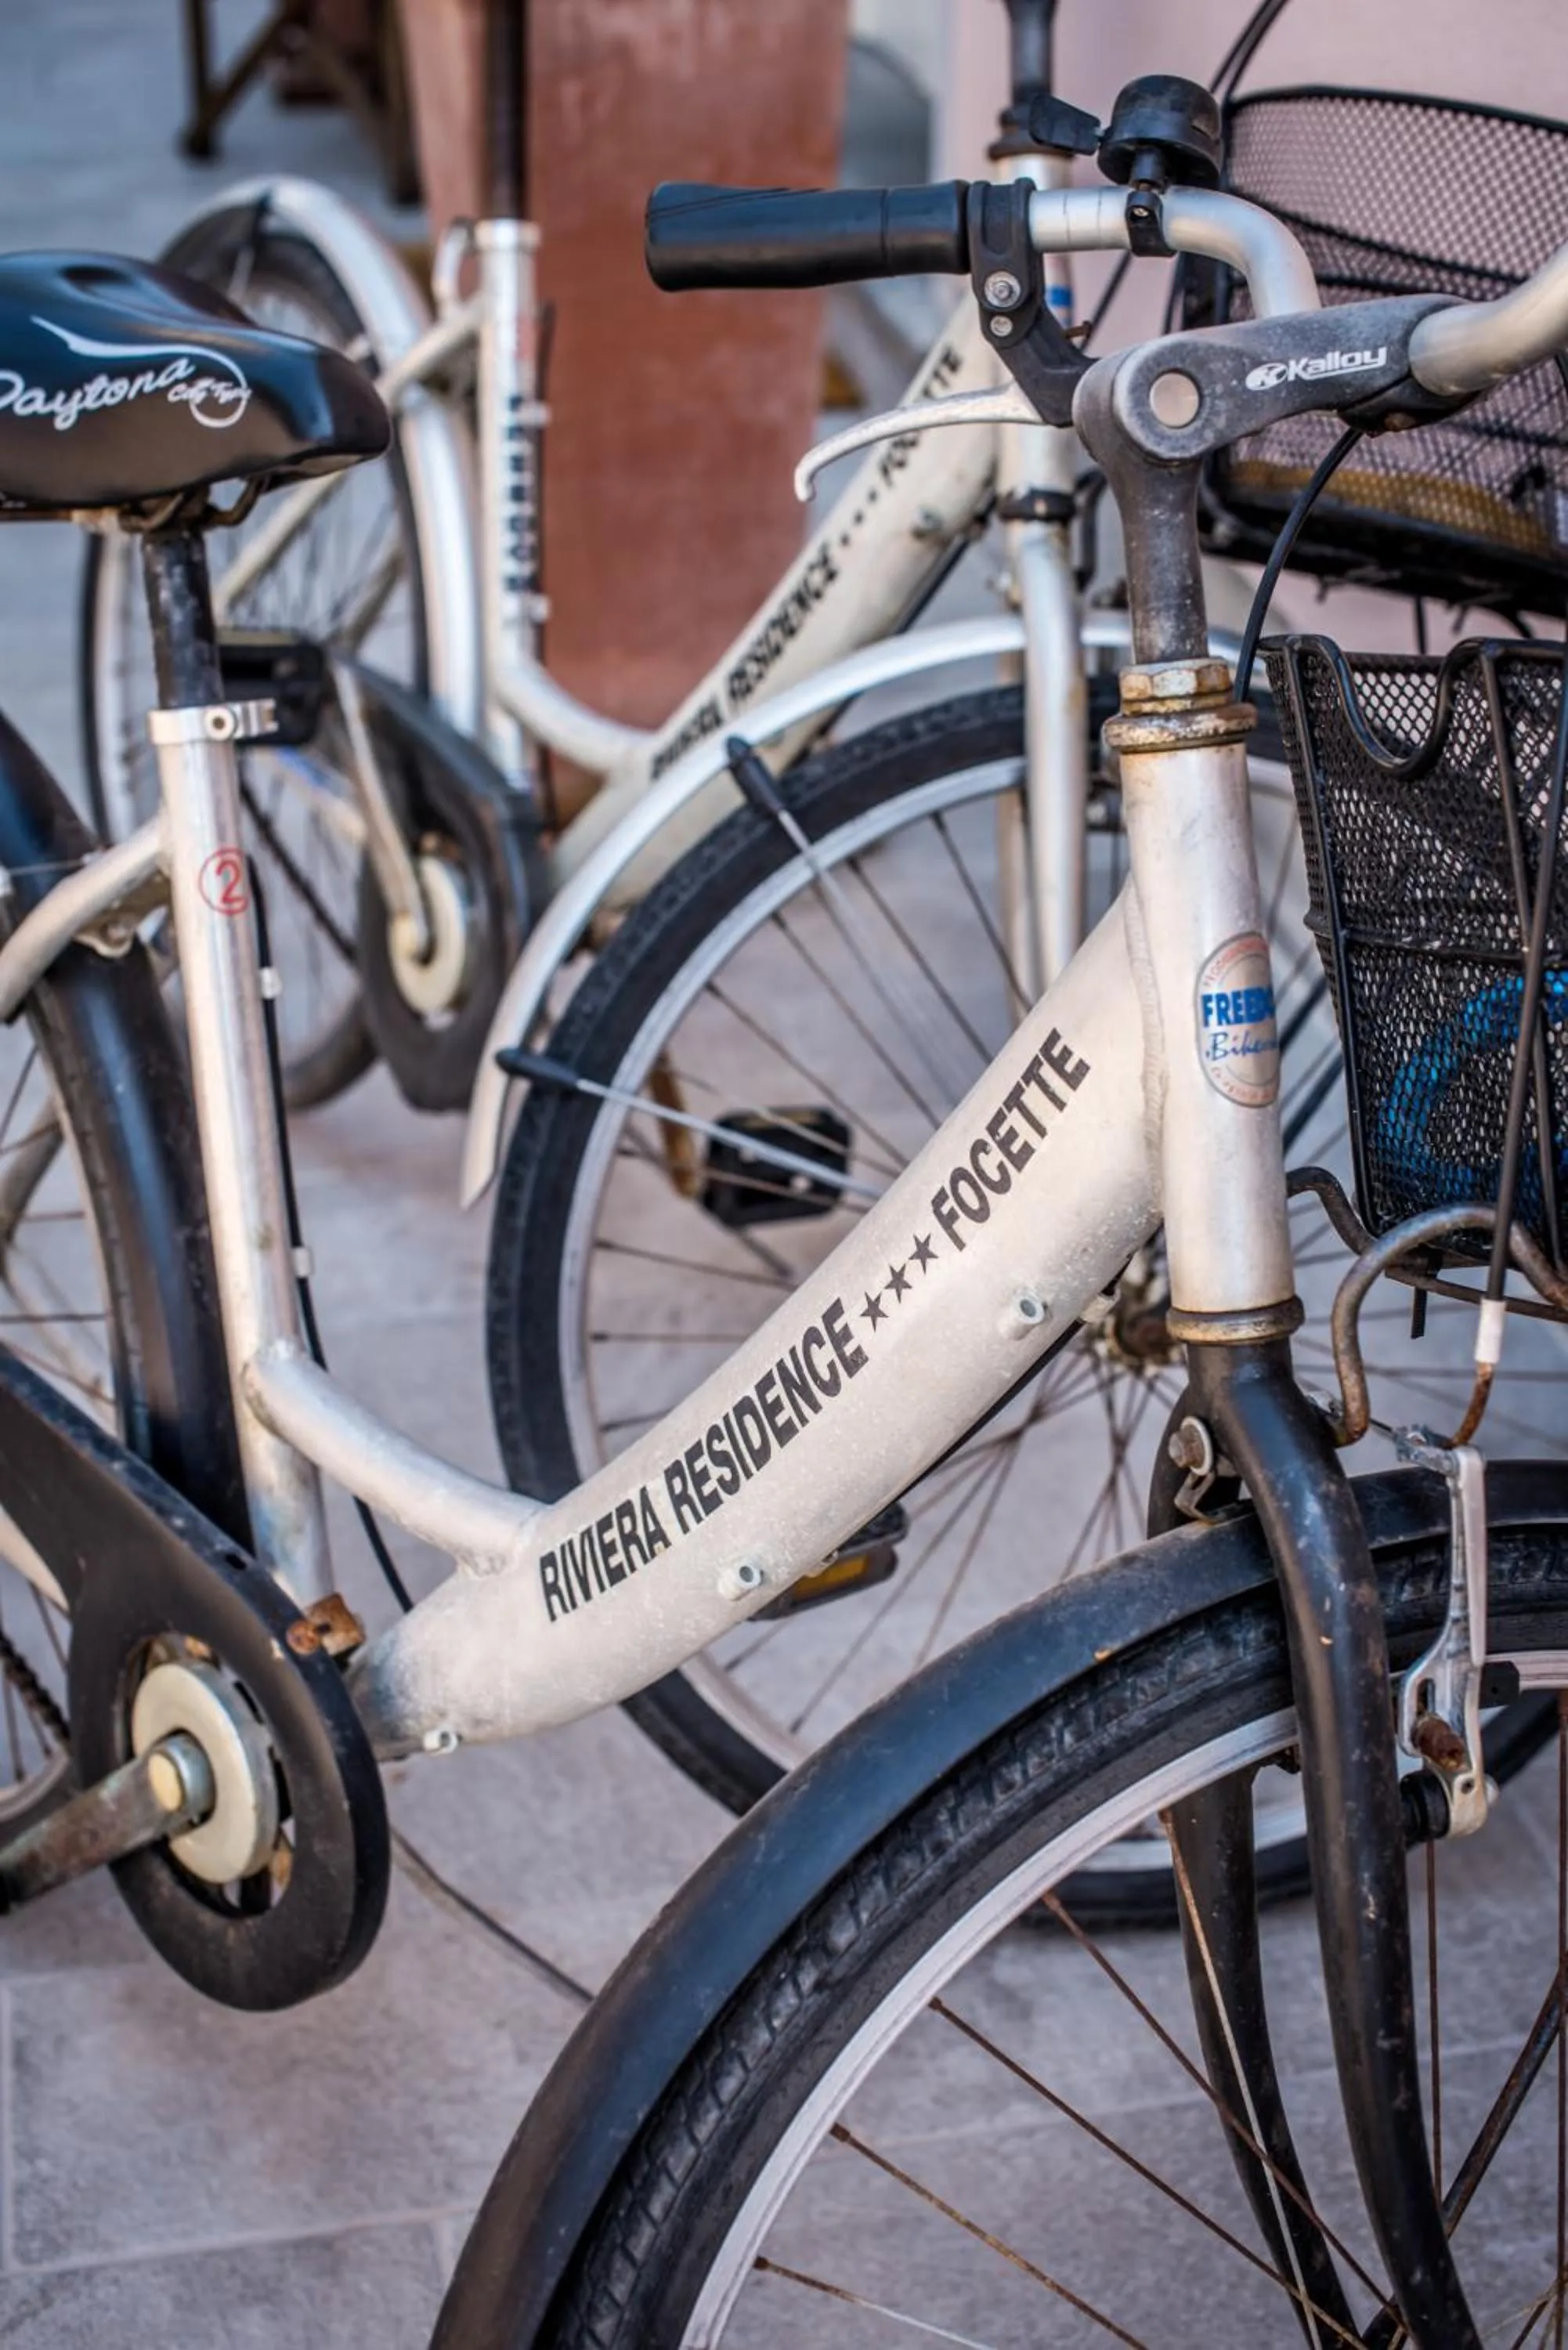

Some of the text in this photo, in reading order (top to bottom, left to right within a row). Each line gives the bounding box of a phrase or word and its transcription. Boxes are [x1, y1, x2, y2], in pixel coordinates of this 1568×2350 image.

[1288, 347, 1387, 382] Kalloy
[539, 1027, 1092, 1622] RIVIERA RESIDENCE FOCETTE
